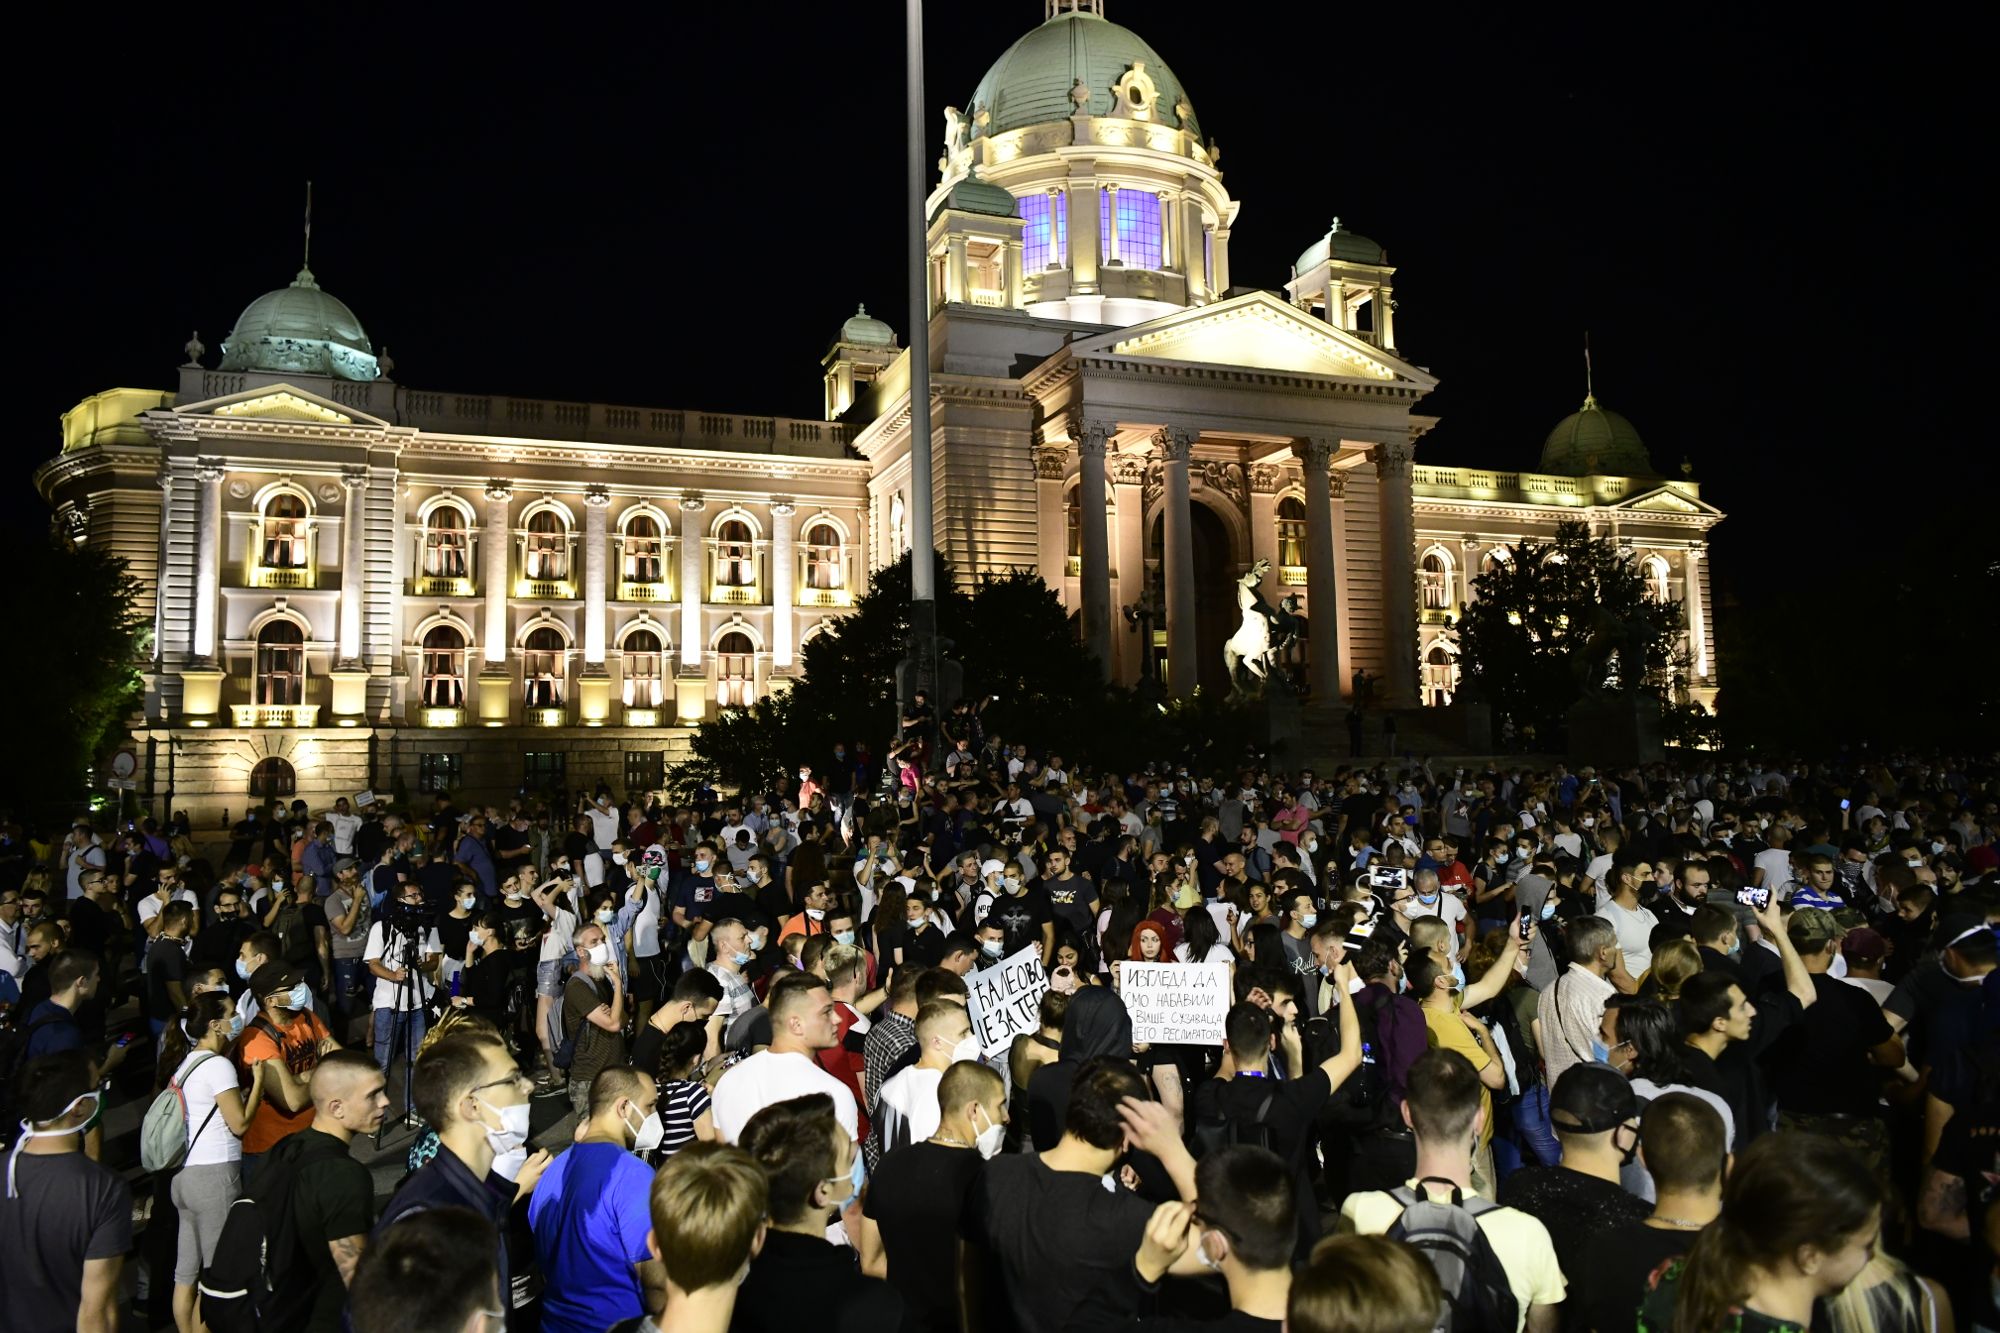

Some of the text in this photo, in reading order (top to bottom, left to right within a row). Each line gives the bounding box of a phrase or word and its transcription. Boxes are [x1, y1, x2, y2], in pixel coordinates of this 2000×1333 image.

[1128, 968, 1217, 989] ИЗГЛЕДА ДА
[1124, 991, 1215, 1009] СМО НАБАВИЛИ
[1136, 1009, 1222, 1026] ВИШЕ СУЗАВАЦА
